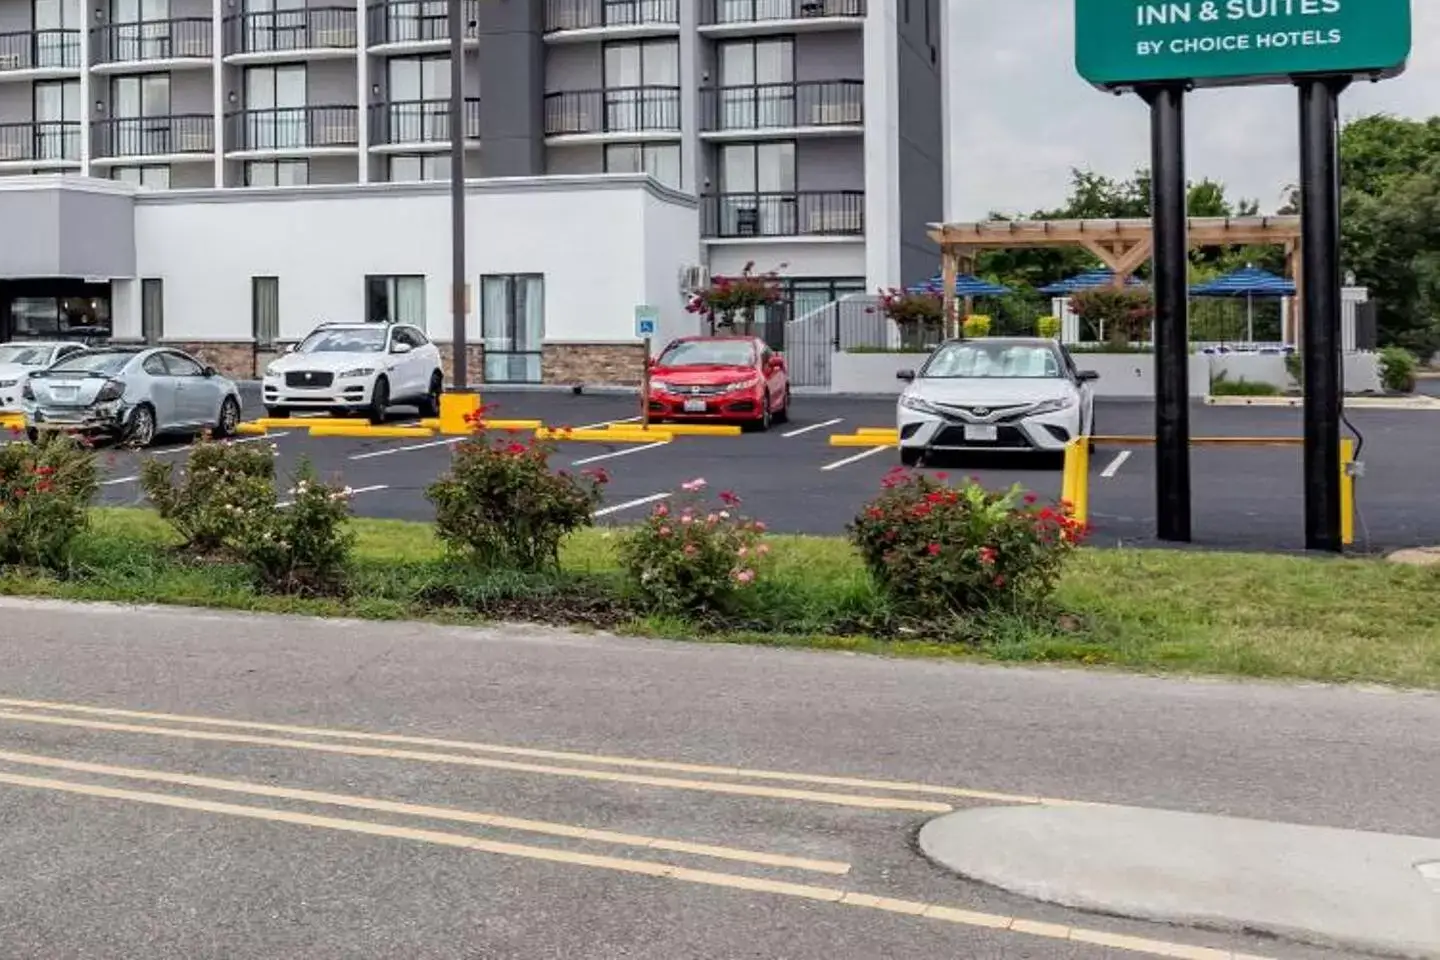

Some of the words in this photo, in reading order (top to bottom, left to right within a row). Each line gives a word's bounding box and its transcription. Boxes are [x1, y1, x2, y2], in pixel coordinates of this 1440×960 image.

[1136, 1, 1192, 27] INN
[1198, 0, 1220, 22] &
[1136, 40, 1162, 56] BY
[1169, 34, 1250, 54] CHOICE
[1256, 28, 1342, 49] HOTELS
